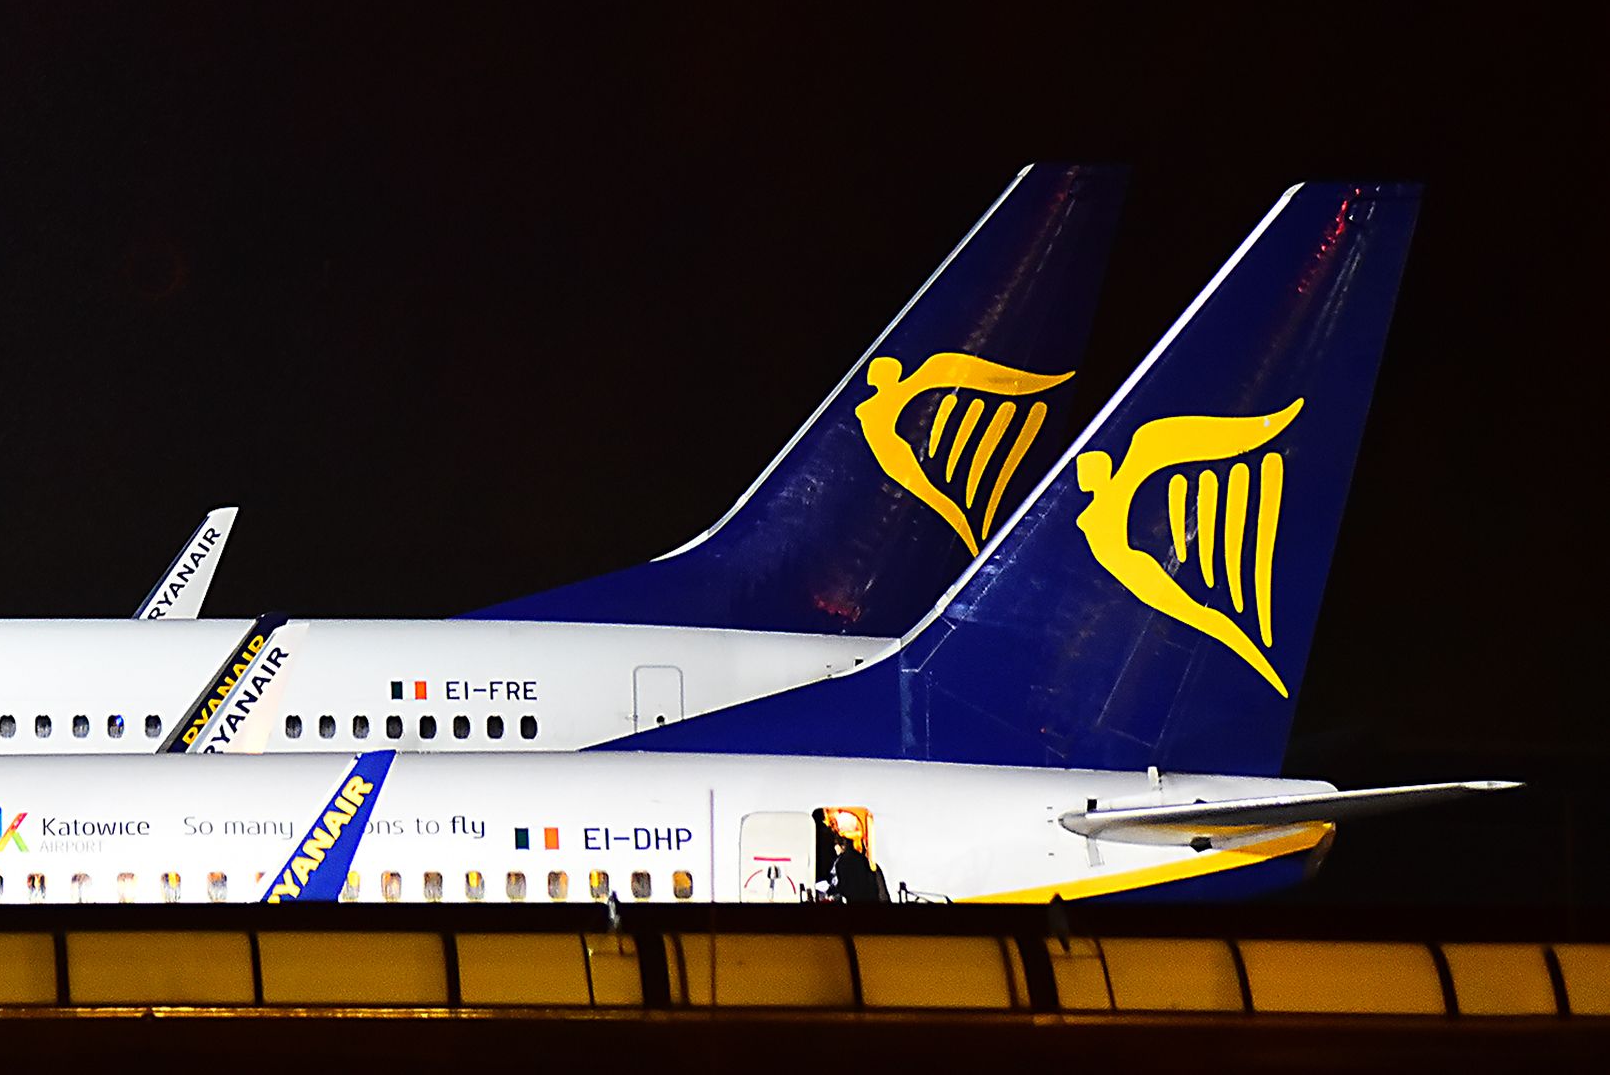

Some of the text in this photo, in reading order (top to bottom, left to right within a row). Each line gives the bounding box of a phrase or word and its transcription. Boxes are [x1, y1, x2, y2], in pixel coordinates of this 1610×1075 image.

[148, 527, 221, 619] RYANAIR
[445, 681, 538, 700] EI-FRE
[42, 817, 150, 836] Katowice
[183, 817, 214, 836] So
[224, 820, 294, 840] many
[415, 818, 440, 835] to
[449, 815, 485, 839] fly
[40, 839, 104, 854] AIRPORT
[267, 775, 375, 904] YANAIR
[583, 827, 693, 850] EI-DHP
